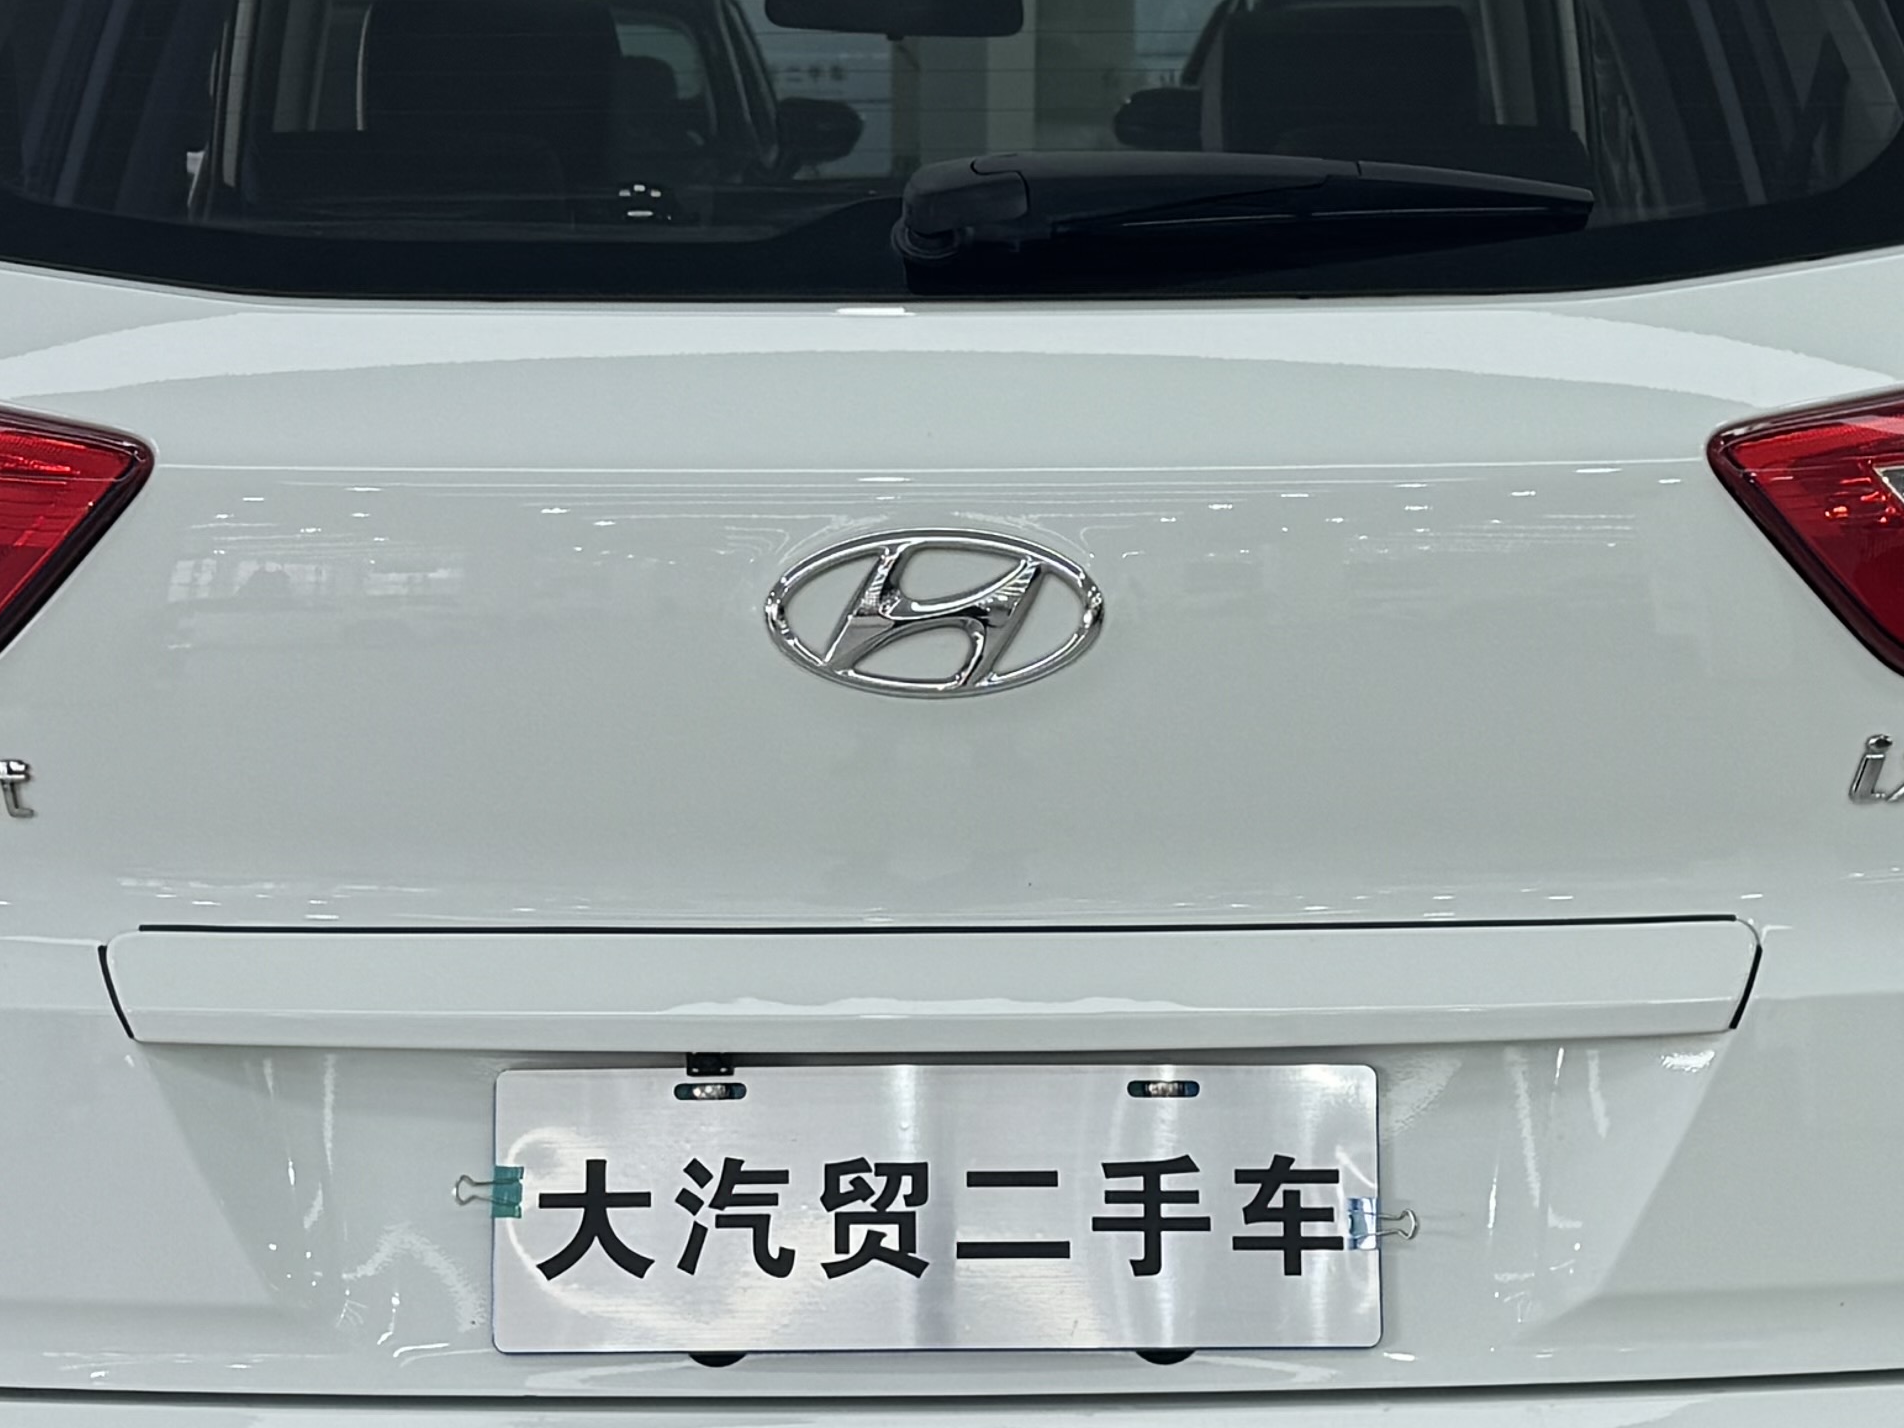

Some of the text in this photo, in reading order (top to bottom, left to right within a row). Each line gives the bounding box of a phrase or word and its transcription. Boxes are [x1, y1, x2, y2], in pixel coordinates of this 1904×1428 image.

[535, 1154, 1346, 1279] 大汽贸二手车
